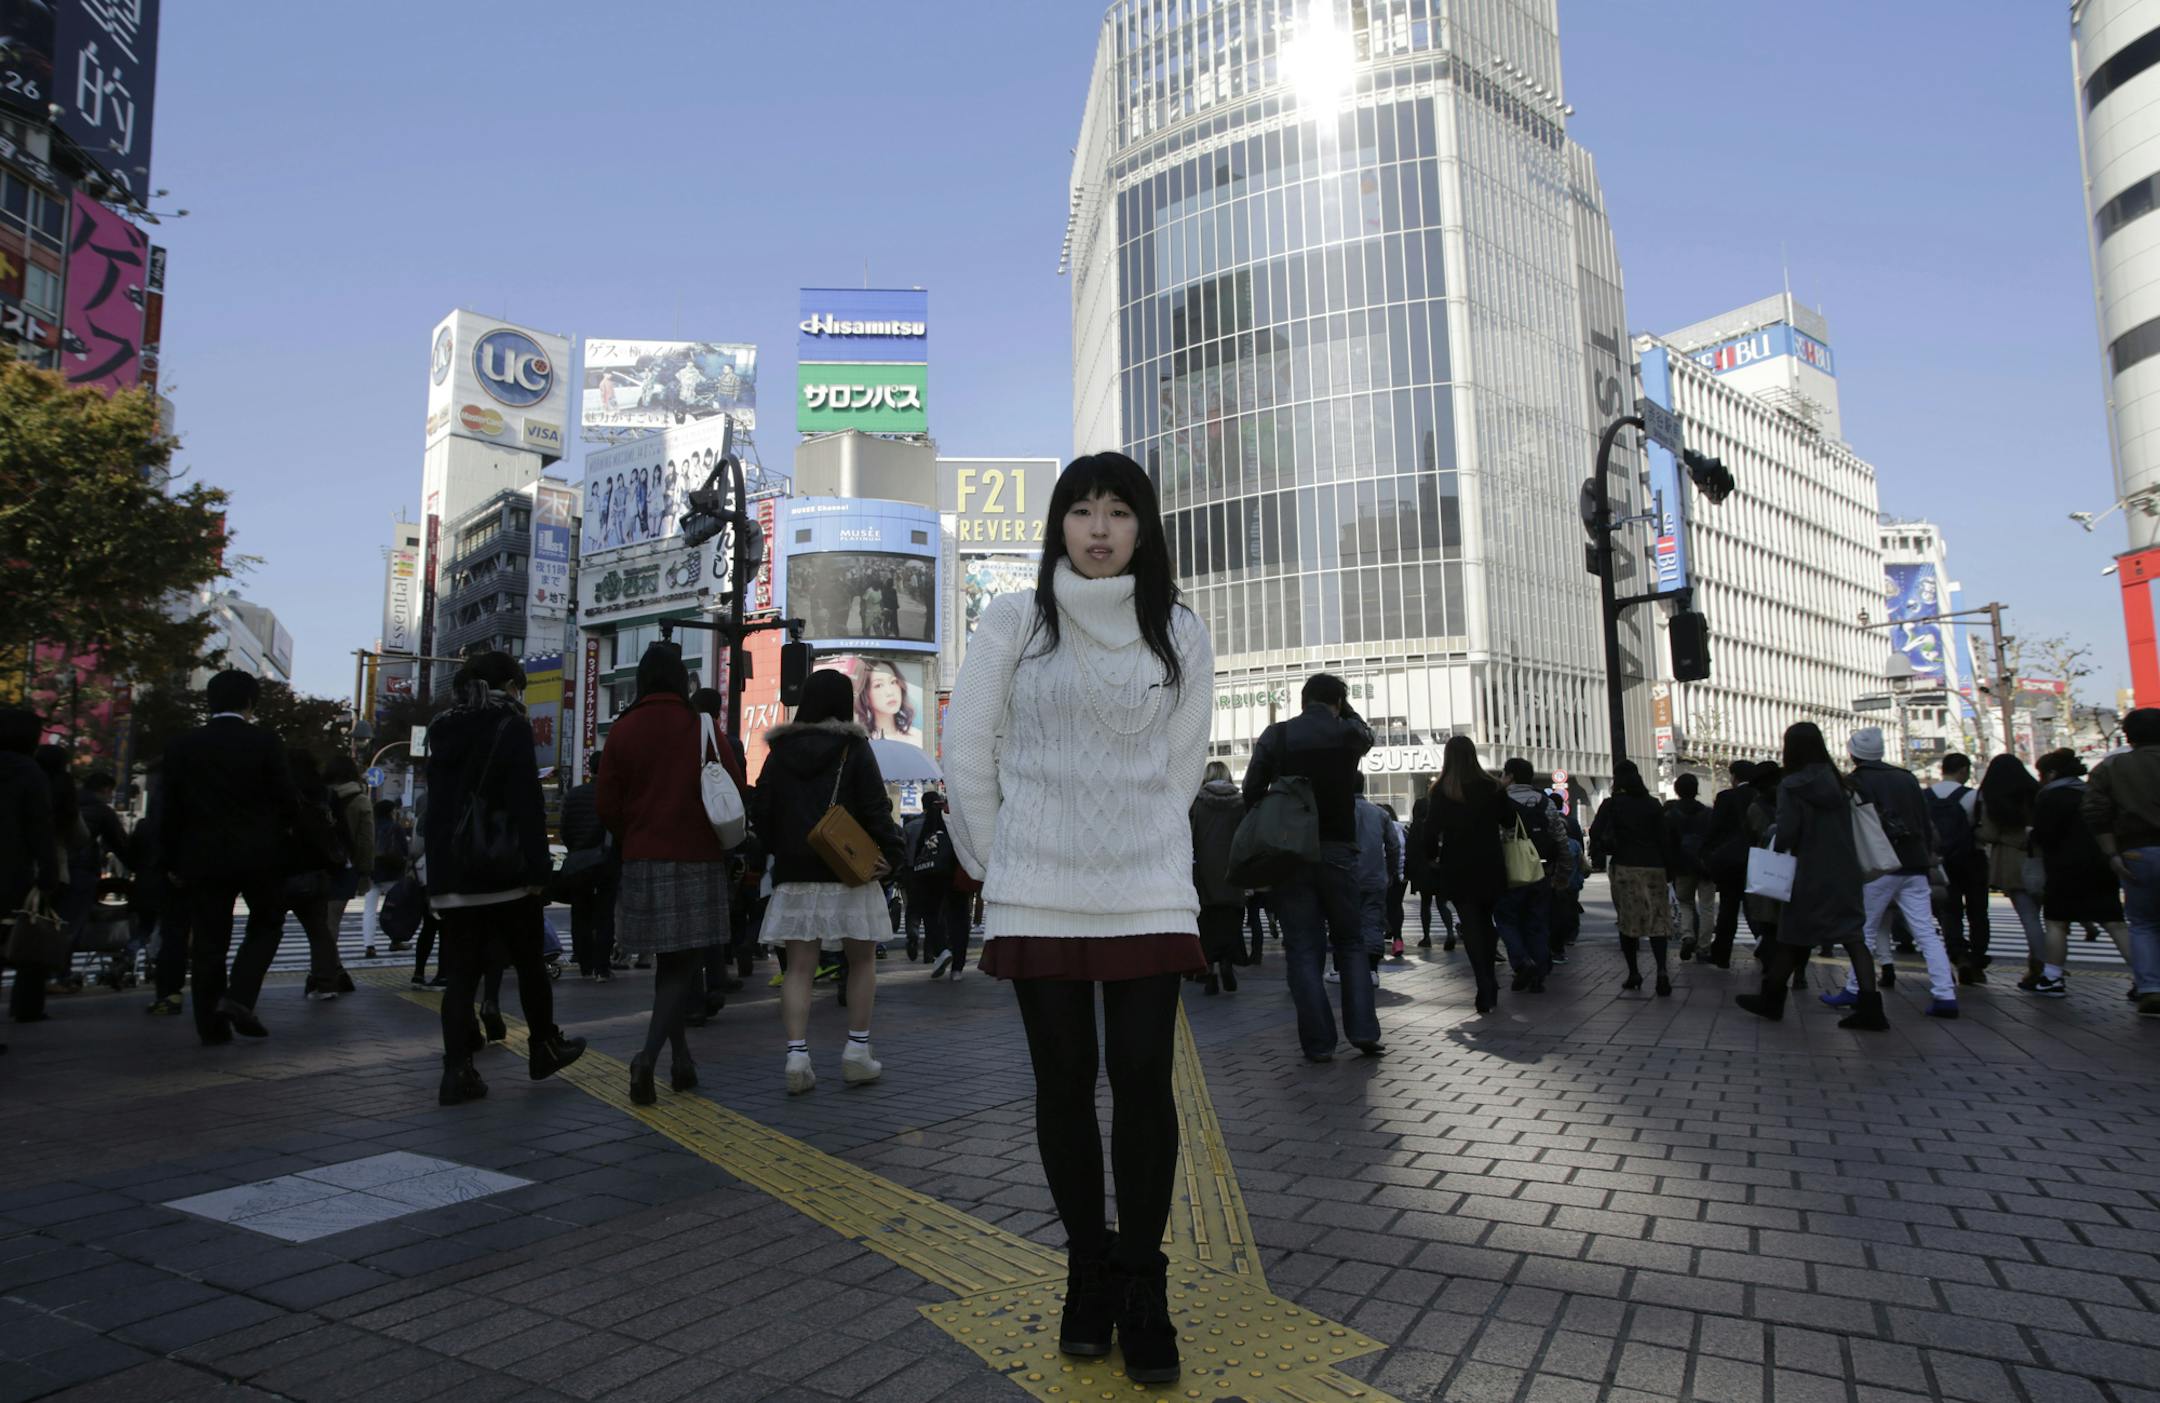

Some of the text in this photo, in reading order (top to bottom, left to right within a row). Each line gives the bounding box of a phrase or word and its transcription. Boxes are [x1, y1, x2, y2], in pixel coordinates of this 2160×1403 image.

[0, 299, 48, 341] スト
[799, 312, 926, 336] Hisamitsu
[1697, 333, 1772, 372] EIBU
[803, 384, 921, 409] サロンパス
[528, 425, 560, 442] VISA
[957, 468, 1026, 514] F21
[959, 519, 1046, 542] REVER 2
[536, 562, 568, 577] 夜11時
[541, 576, 561, 588] まで
[549, 592, 568, 606] 地下
[388, 576, 409, 650] Essential
[1219, 688, 1288, 708] RBUCKS
[744, 702, 781, 730] クスリ
[1365, 746, 1445, 773] SUTA
